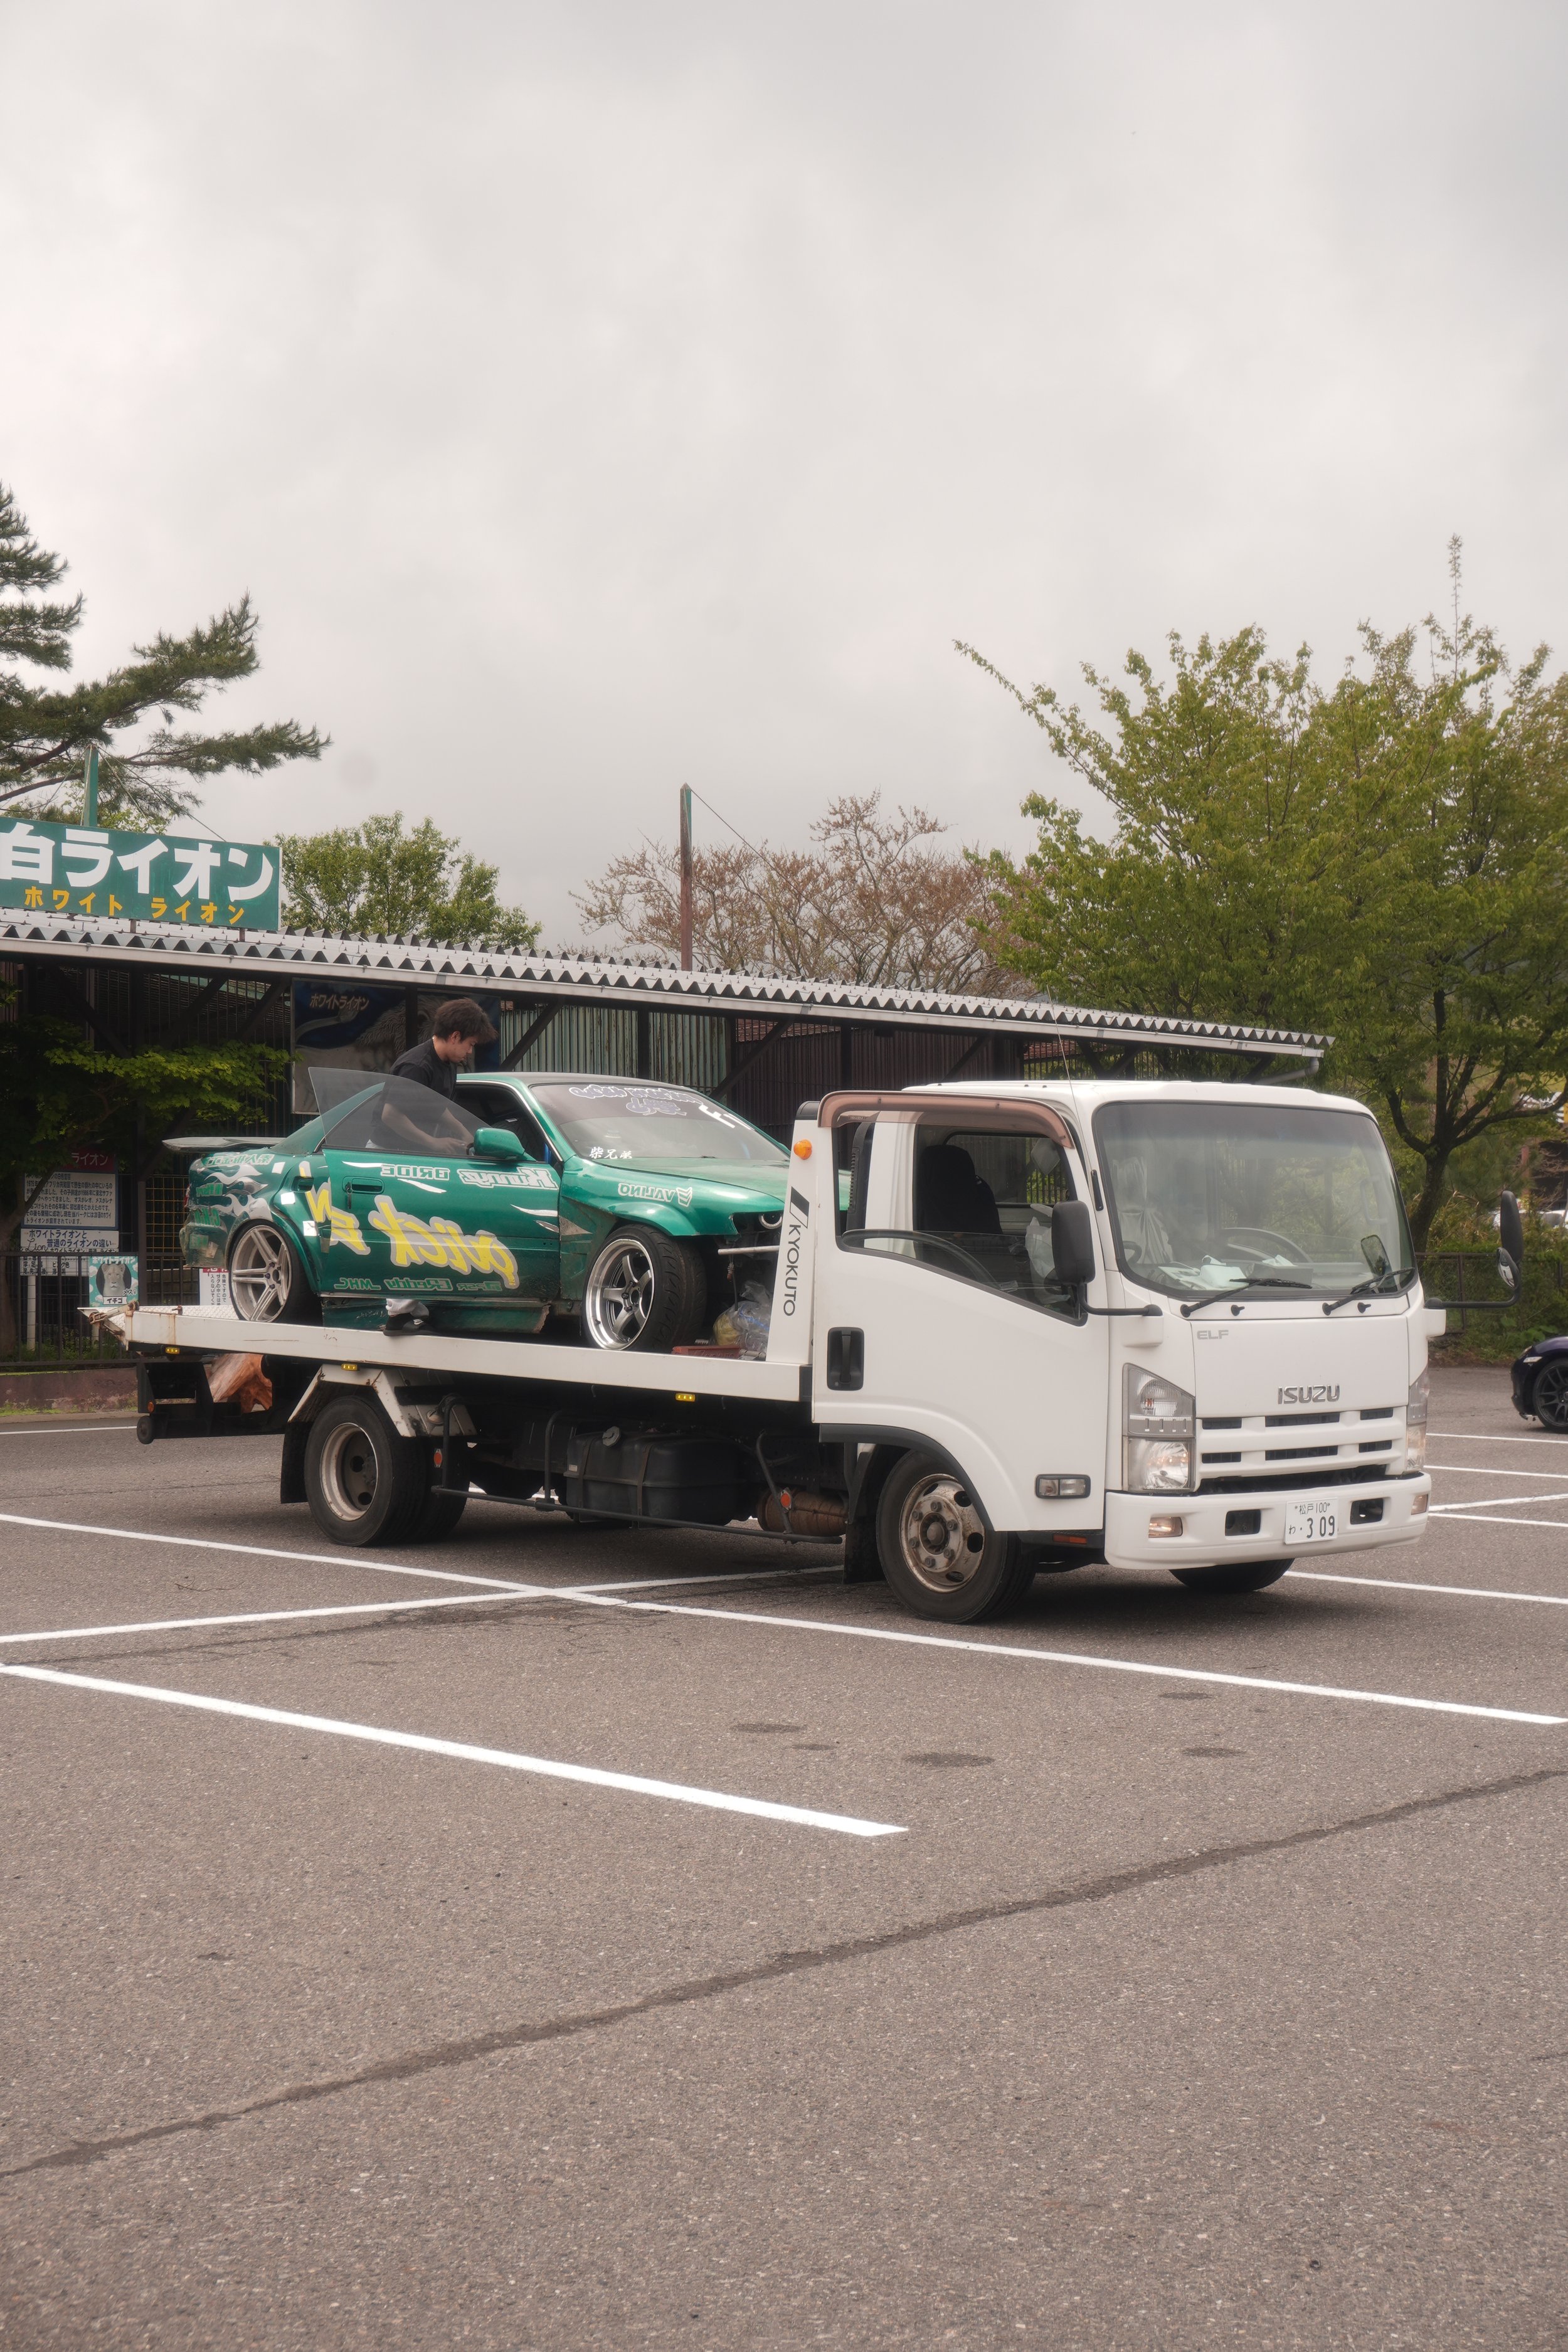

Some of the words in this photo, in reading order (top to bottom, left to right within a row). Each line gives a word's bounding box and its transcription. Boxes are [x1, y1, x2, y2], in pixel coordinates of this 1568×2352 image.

[24, 886, 123, 916] ホワイト
[150, 897, 245, 924] ライオン
[309, 993, 369, 1011] ホワイトライオン
[589, 1146, 633, 1160] 柴兄弟
[29, 1229, 87, 1239] ホワイトライオンと
[26, 1237, 48, 1252] Lion
[47, 1239, 112, 1248] 普通のライオンの違い
[92, 1256, 135, 1264] ホワイトライオン
[783, 1224, 801, 1316] KYOKUTO
[1197, 1329, 1229, 1340] ELF
[1278, 1384, 1340, 1405] ISUZU
